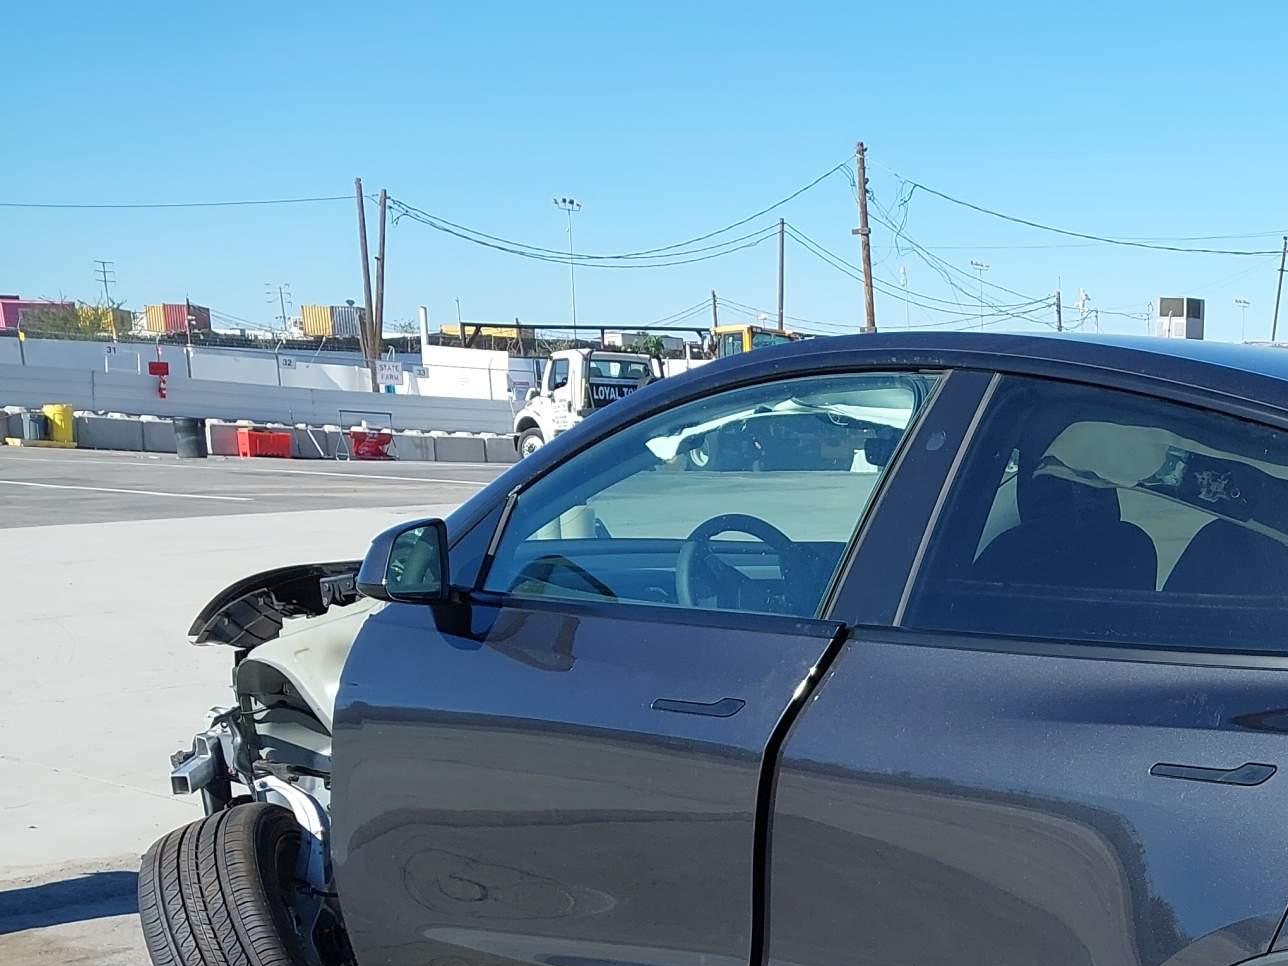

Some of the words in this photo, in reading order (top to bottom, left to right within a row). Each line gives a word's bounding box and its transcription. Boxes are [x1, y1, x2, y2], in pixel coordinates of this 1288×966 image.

[106, 345, 117, 354] 31
[282, 358, 292, 367] 32
[593, 385, 620, 400] LOYAL
[622, 387, 637, 398] TO
